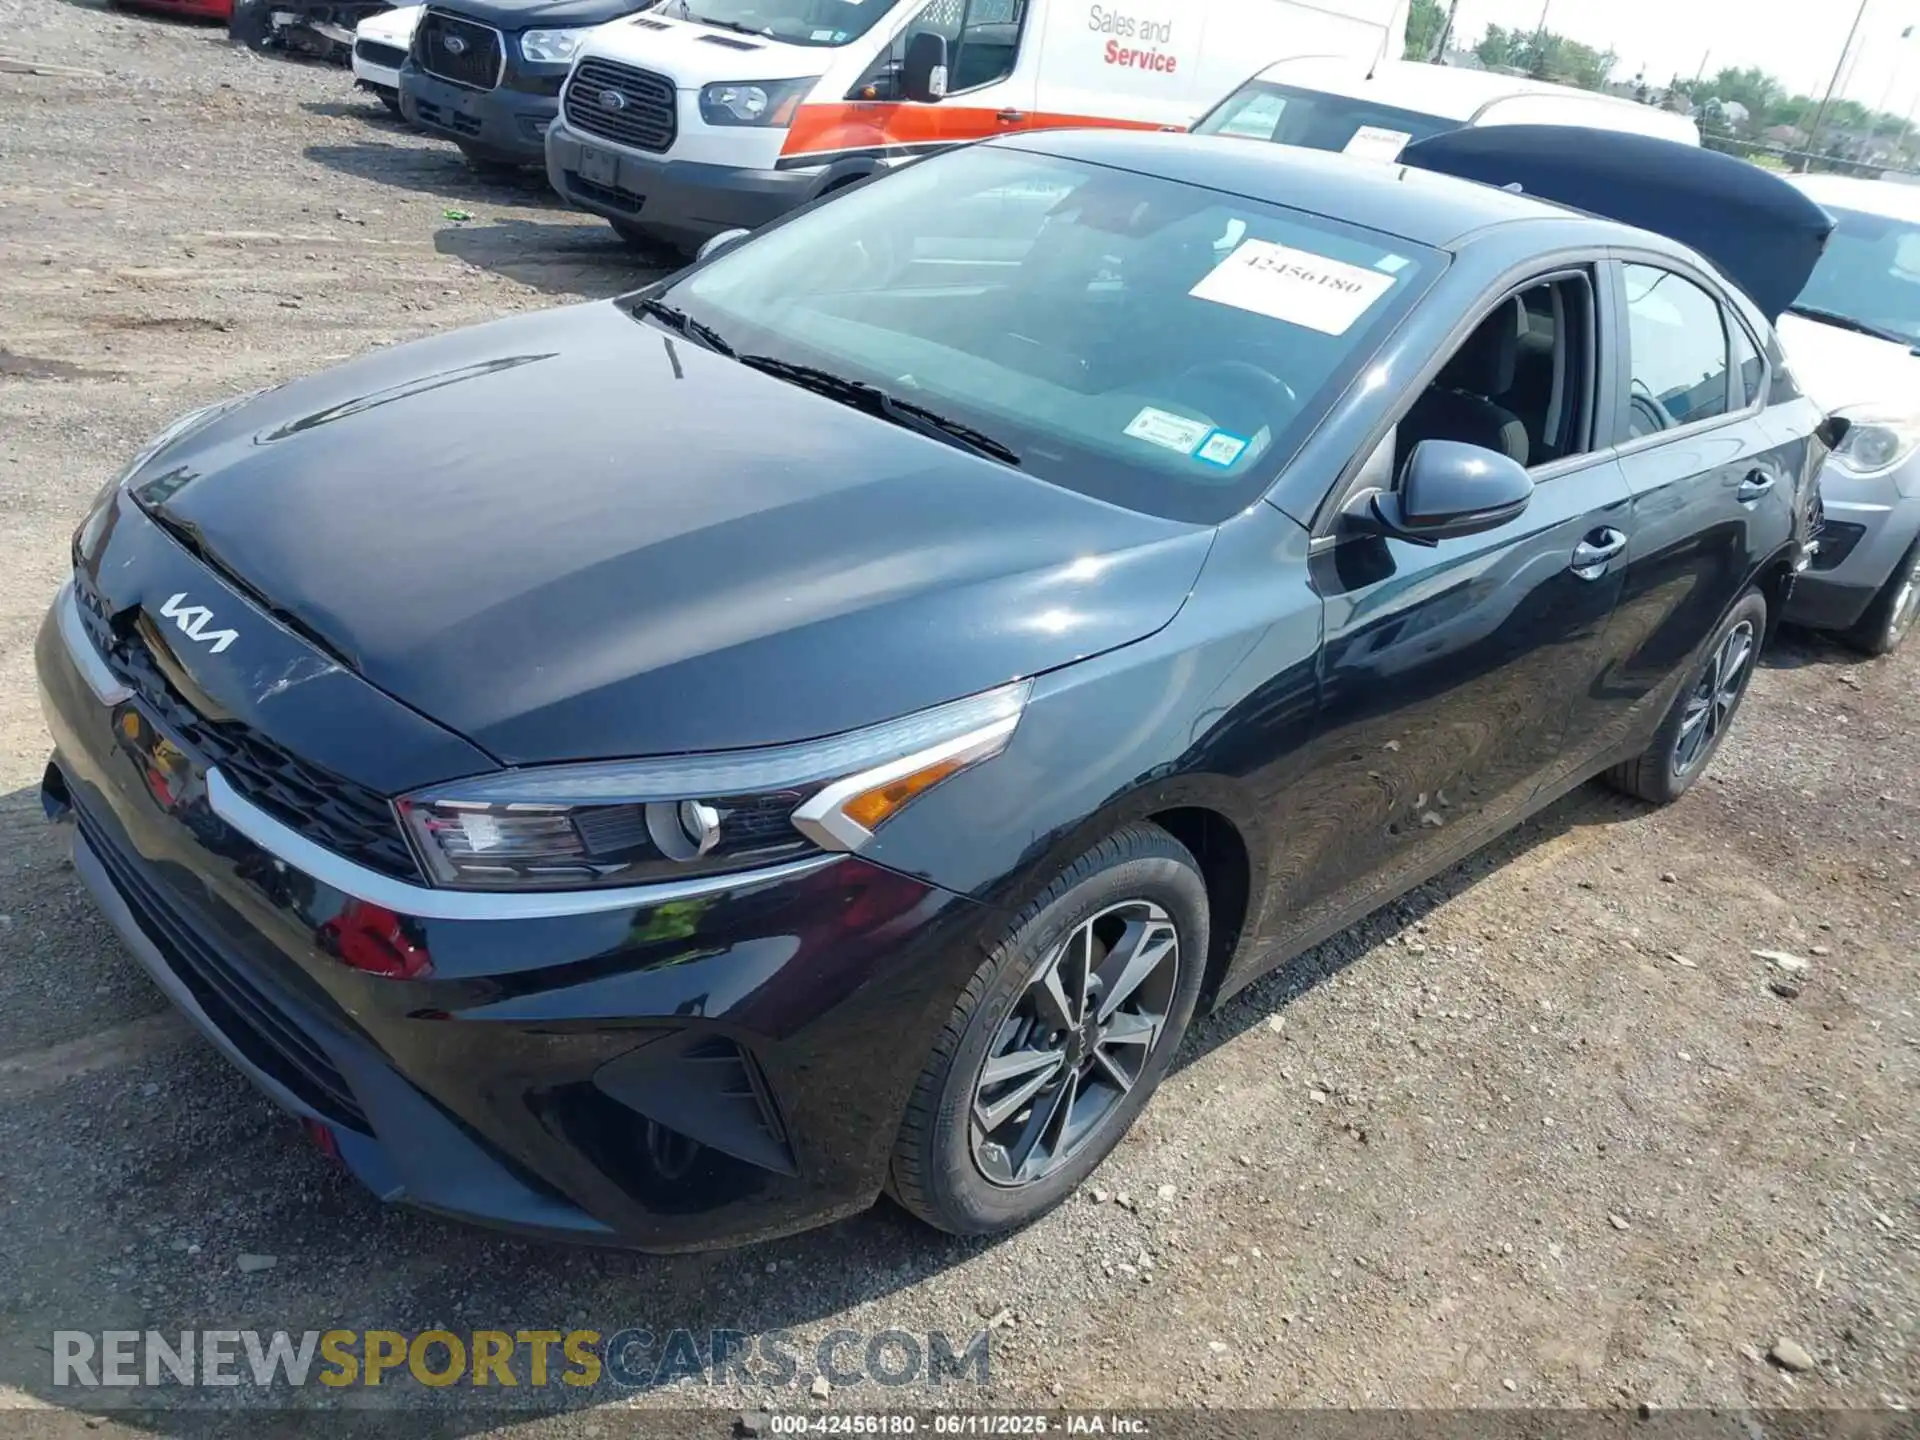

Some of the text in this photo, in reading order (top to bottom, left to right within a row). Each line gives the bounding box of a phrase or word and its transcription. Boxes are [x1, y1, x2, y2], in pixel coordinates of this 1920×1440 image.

[1088, 4, 1172, 43] Sales and
[1104, 39, 1177, 73] Service
[1245, 256, 1363, 293] 42456180
[160, 592, 239, 653] KIA
